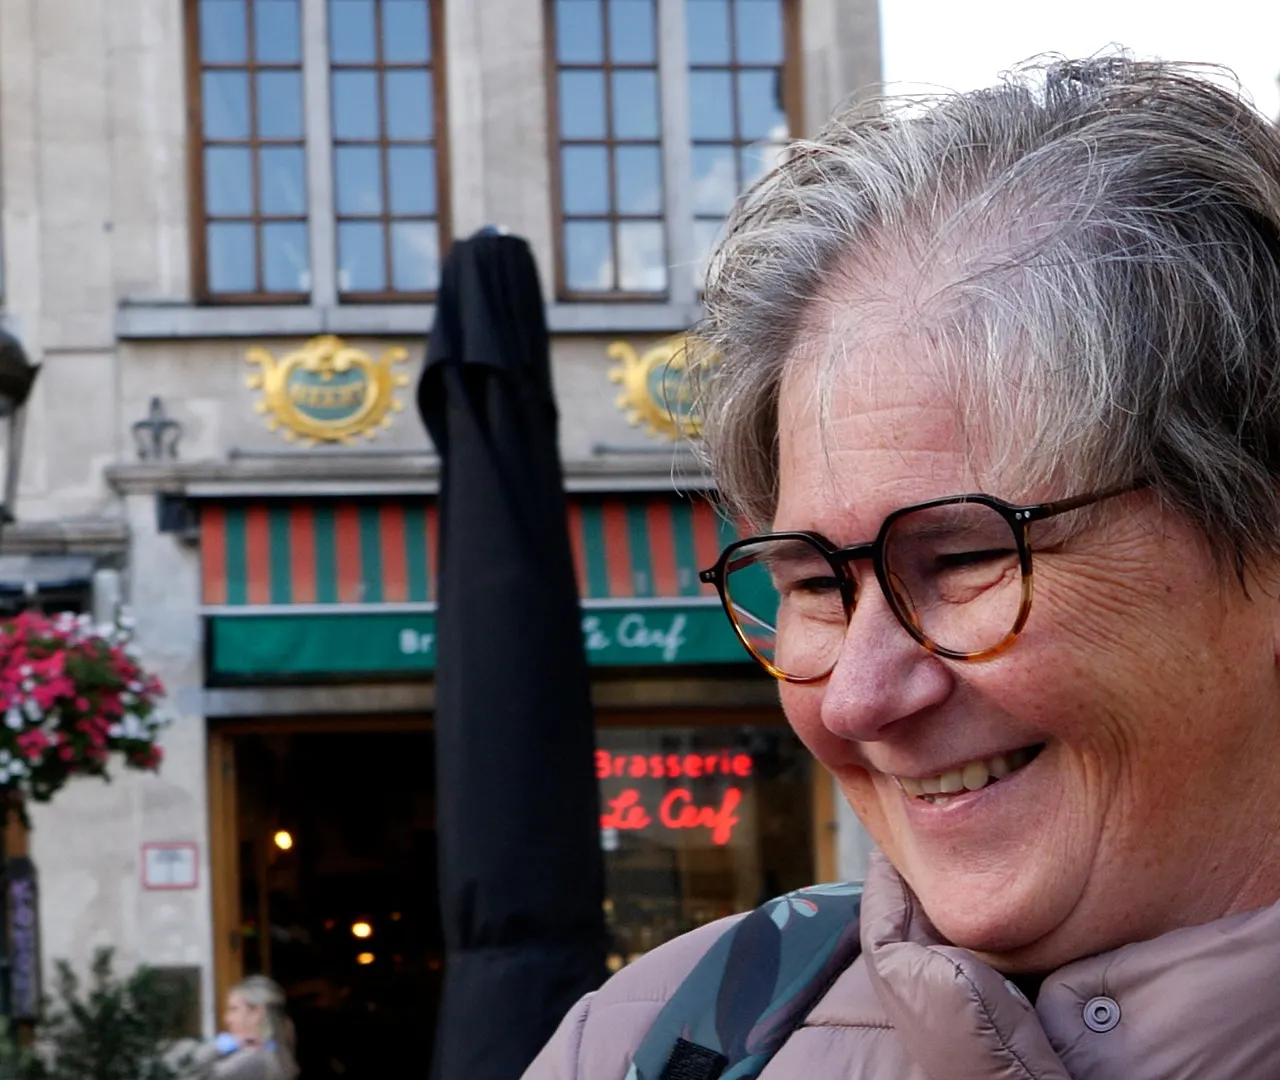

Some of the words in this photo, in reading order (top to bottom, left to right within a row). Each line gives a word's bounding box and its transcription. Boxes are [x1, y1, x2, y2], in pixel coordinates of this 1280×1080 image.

[617, 613, 688, 662] Cerf
[595, 748, 753, 779] Brasserie
[599, 788, 651, 830] Le
[659, 787, 742, 846] Cerf
